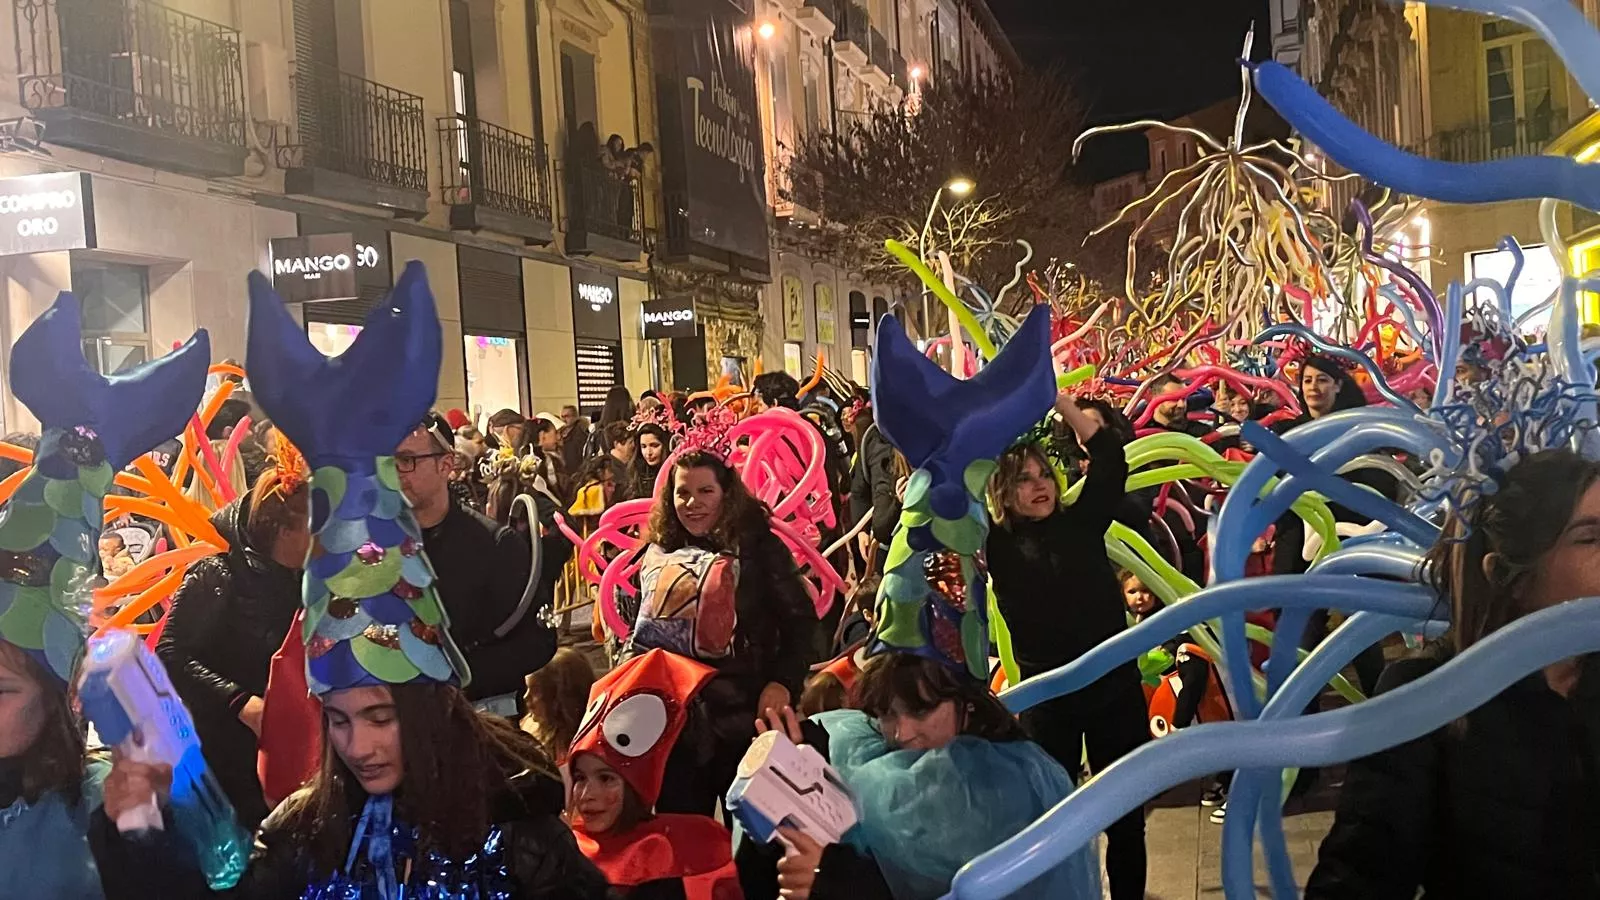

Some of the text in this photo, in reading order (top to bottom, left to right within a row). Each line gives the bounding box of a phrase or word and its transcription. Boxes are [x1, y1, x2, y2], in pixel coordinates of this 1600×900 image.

[17, 216, 59, 237] ORO
[274, 253, 350, 275] MANGO
[578, 283, 613, 304] MANGO
[644, 309, 693, 323] MANGO
